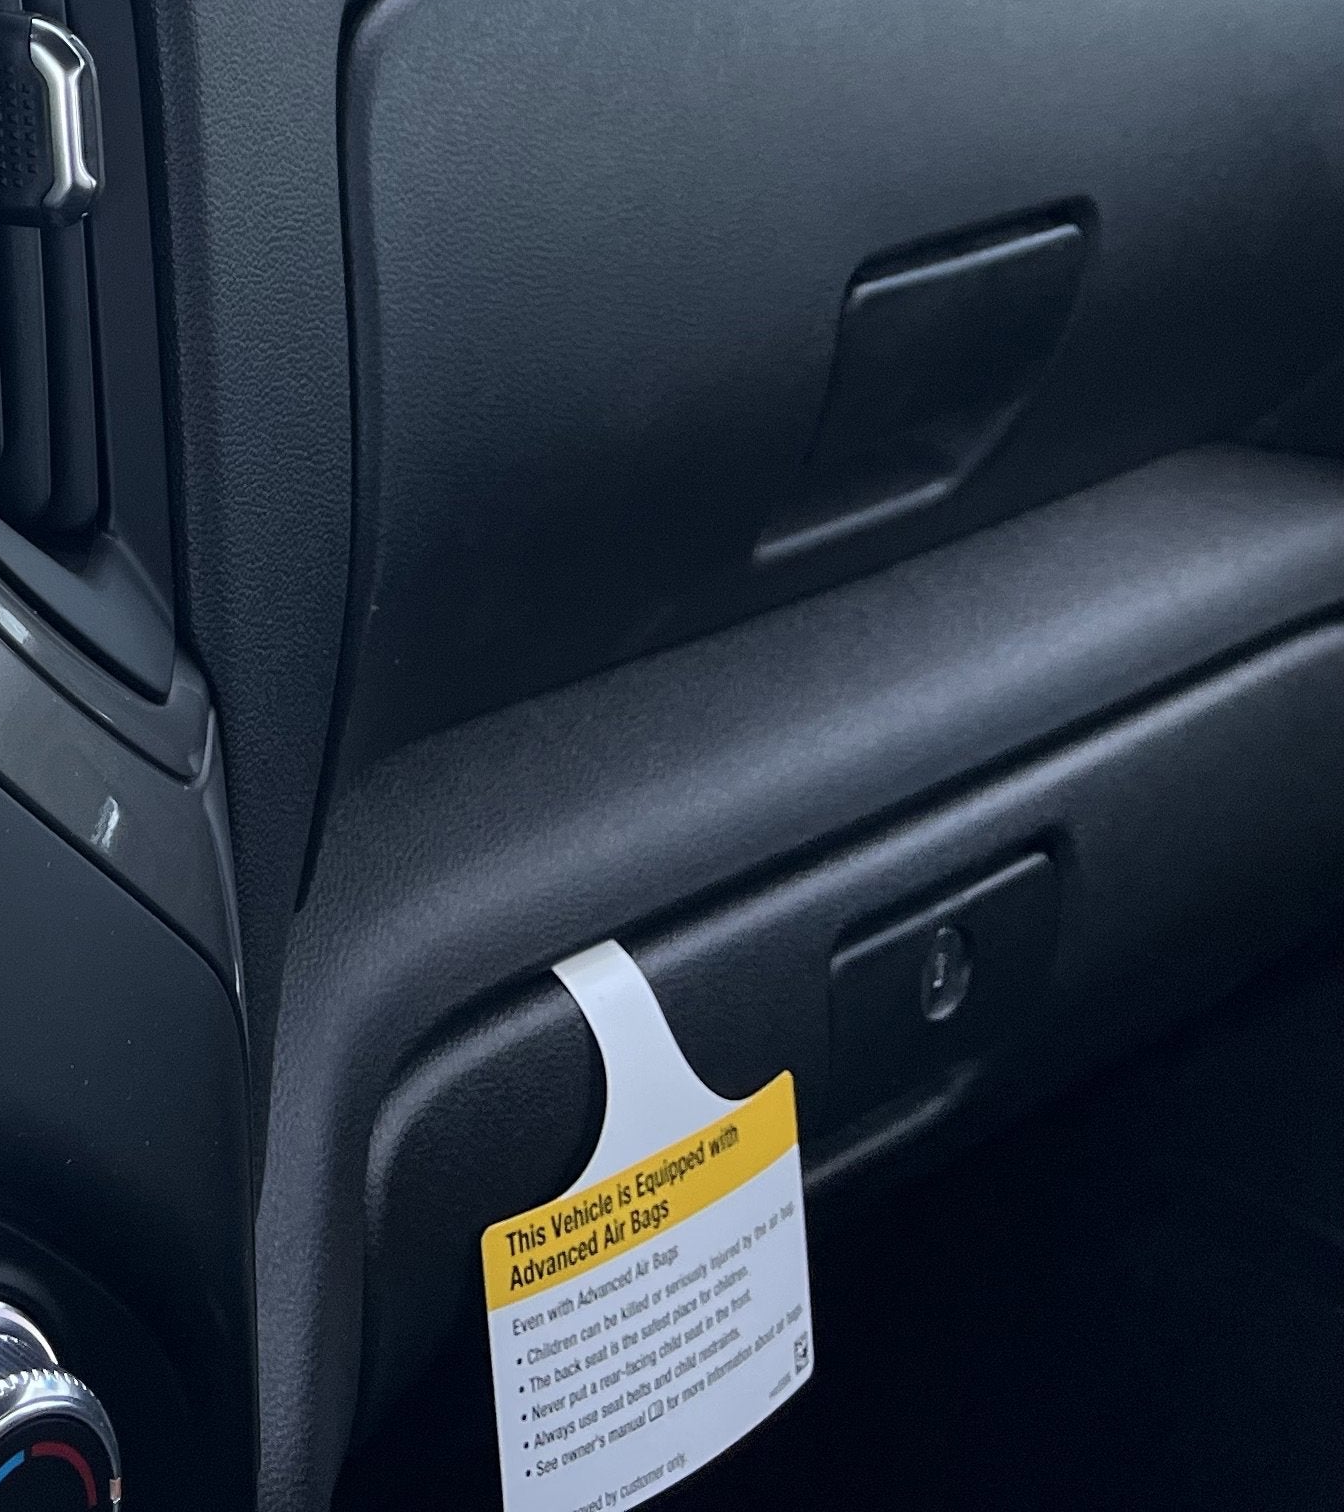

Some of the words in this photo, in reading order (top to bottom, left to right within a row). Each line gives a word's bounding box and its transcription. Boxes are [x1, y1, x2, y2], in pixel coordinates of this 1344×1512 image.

[505, 1224, 547, 1257] This
[551, 1193, 613, 1238] Vehicle
[617, 1182, 632, 1208] is
[635, 1140, 705, 1198] Equipped
[708, 1123, 740, 1158] with
[510, 1230, 599, 1291] Advanced
[604, 1218, 626, 1249] Air
[630, 1199, 669, 1235] Bags
[512, 1312, 545, 1336] Even
[547, 1297, 575, 1322] with
[577, 1266, 633, 1309] Advanced
[526, 1332, 578, 1365] Children
[528, 1372, 551, 1393] The
[554, 1358, 582, 1384] back
[531, 1395, 566, 1421] Never
[533, 1420, 576, 1450] Always
[578, 1409, 599, 1430] use
[535, 1456, 558, 1478] See
[561, 1433, 606, 1467] owner's
